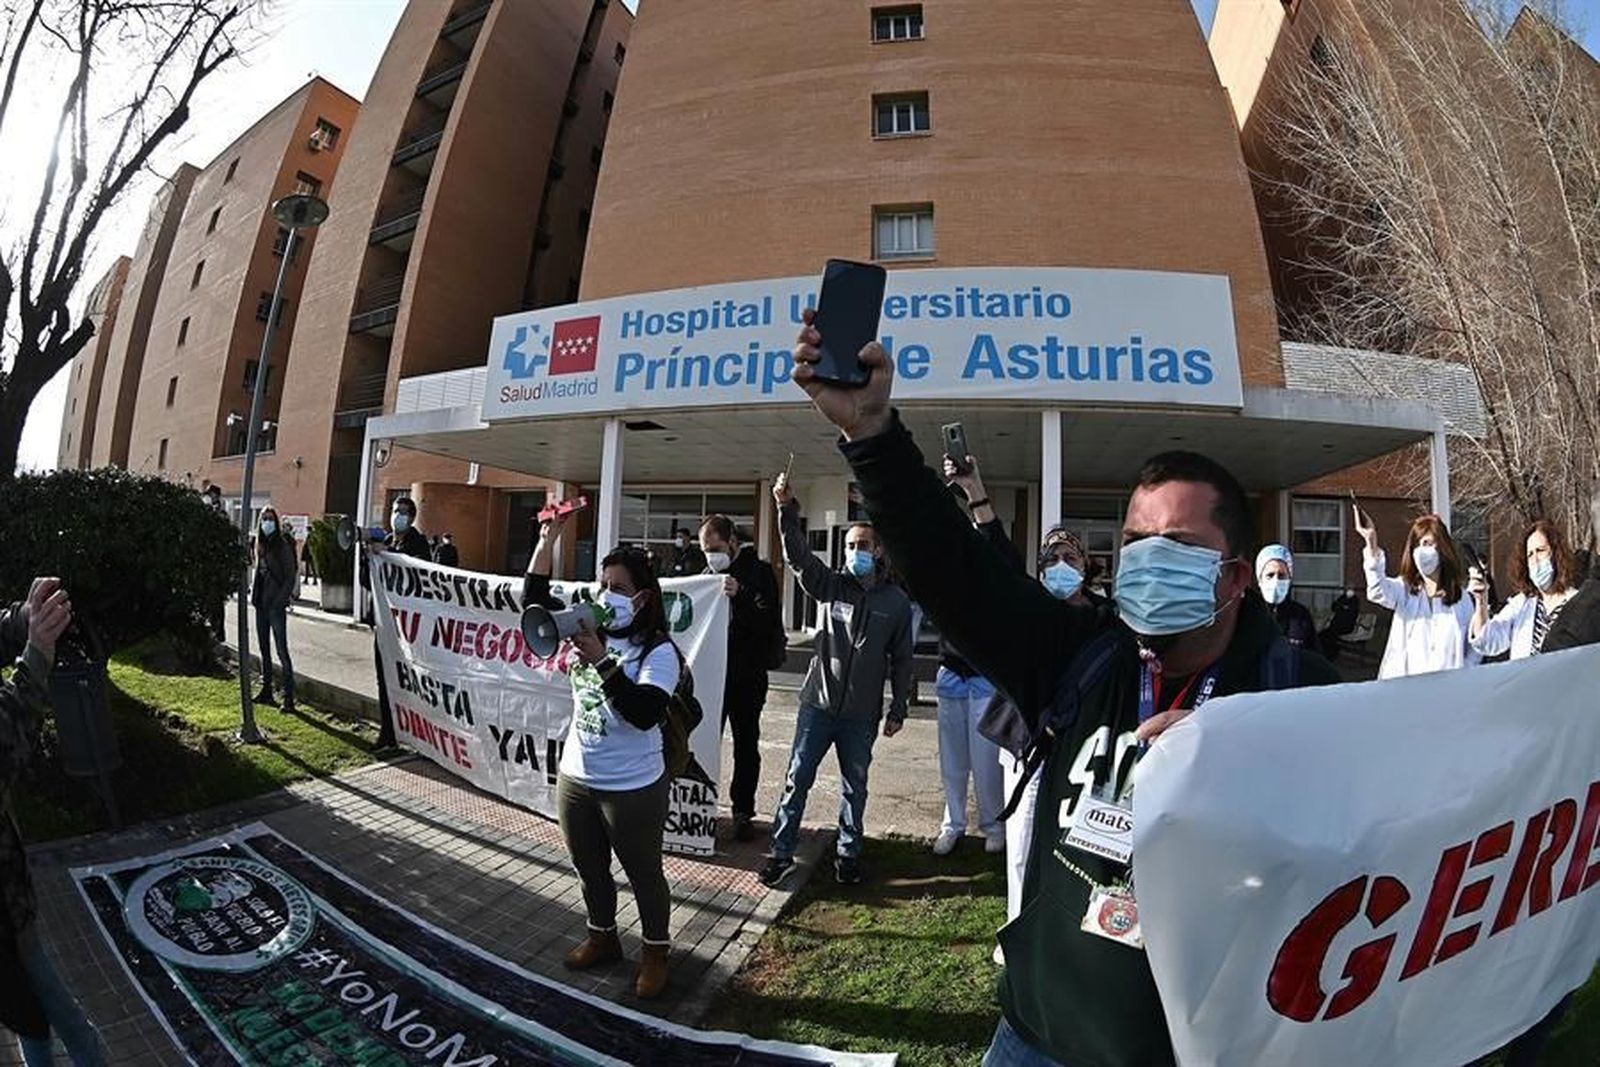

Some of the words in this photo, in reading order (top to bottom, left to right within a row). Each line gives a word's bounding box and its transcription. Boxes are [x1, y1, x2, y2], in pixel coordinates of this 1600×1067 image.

[620, 296, 772, 338] Hospital
[790, 287, 1071, 324] Uersitario
[614, 343, 794, 394] Príncip
[961, 333, 1214, 385] Asturias
[499, 376, 599, 404] SaludMadrid
[390, 607, 421, 645] TU
[395, 660, 475, 726] BASTA
[394, 702, 473, 770] DIMITE
[1088, 808, 1133, 833] mats
